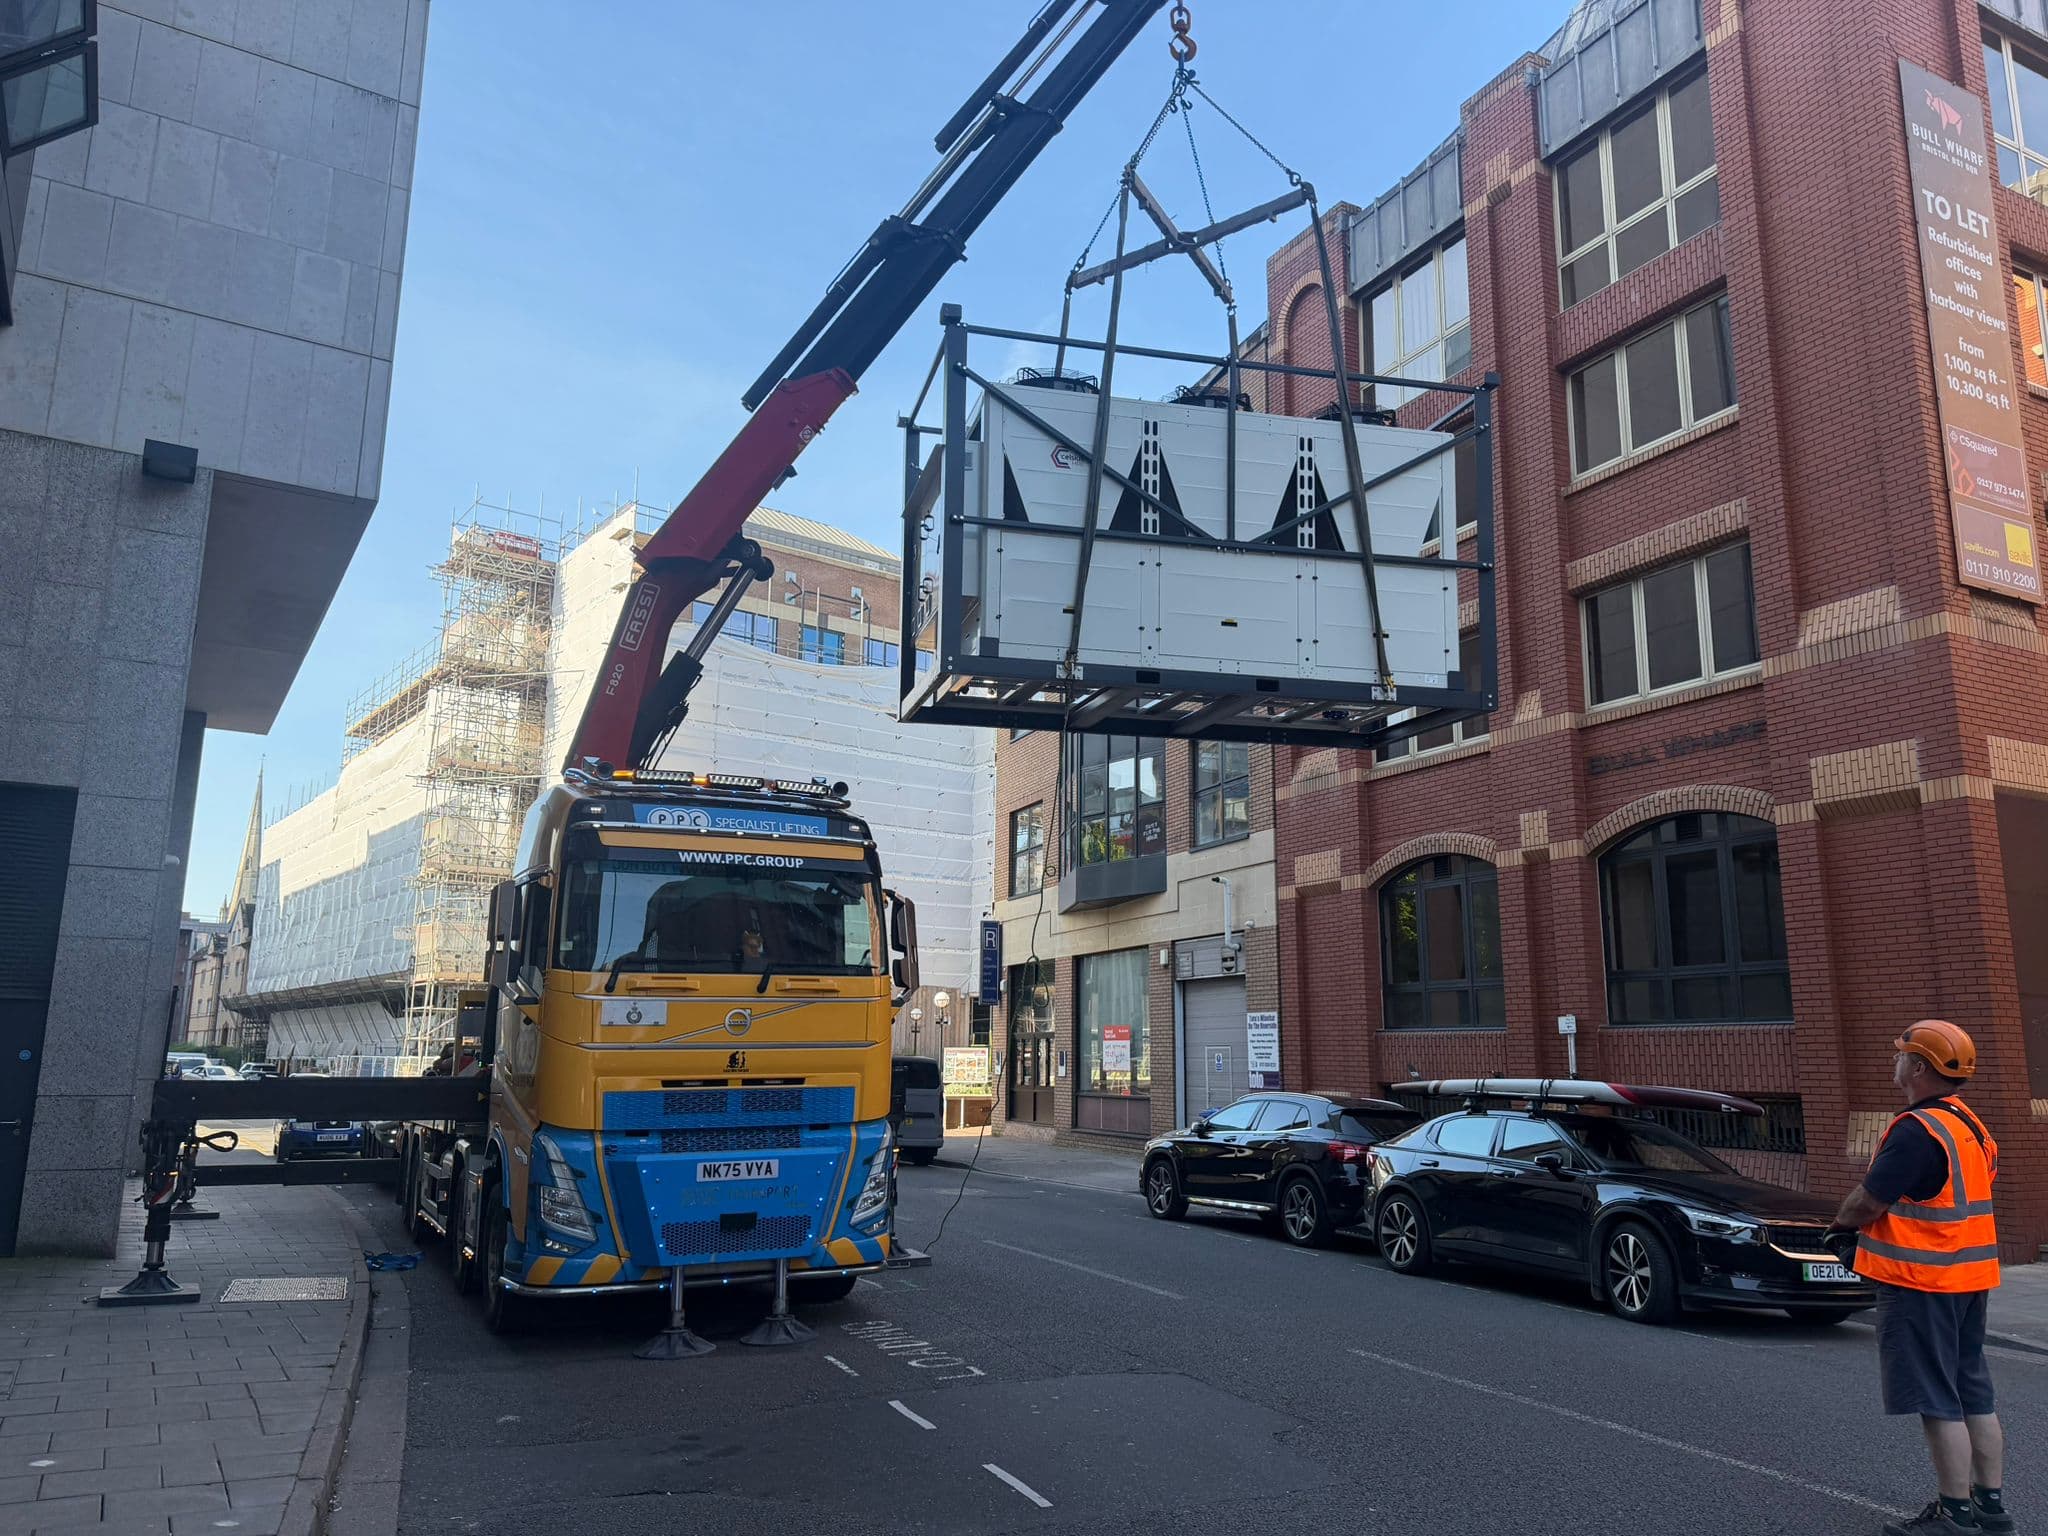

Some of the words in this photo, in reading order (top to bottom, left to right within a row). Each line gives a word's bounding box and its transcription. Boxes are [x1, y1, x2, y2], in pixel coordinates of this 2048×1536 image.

[1911, 122, 1941, 147] BULL
[1945, 137, 1984, 166] WHARF
[1921, 142, 1950, 162] BRISTOL
[1921, 188, 1952, 221] TO
[1955, 203, 1990, 239] LET
[1928, 226, 1993, 267] Refurbished
[1945, 256, 1982, 281] offices
[1954, 280, 1979, 300] with
[1929, 288, 1975, 318] harbour
[1976, 309, 2007, 332] views
[1958, 336, 1985, 360] from
[1943, 352, 1972, 376] 1,100
[1973, 365, 1987, 385] sq
[1987, 367, 1999, 387] ft
[1946, 374, 1984, 401] 10,300
[1984, 390, 1999, 410] sq
[2000, 393, 2011, 411] ft
[1959, 434, 1998, 458] CSquared
[1966, 558, 1990, 577] 0117
[1992, 566, 2011, 583] 910
[2012, 571, 2037, 590] 2200
[625, 588, 656, 645] FASSI
[605, 663, 625, 696] F820
[715, 816, 776, 832] SPECIALIST
[778, 820, 820, 836] LIFTING
[678, 851, 804, 869] WWW.PPC.GROUP
[985, 930, 996, 948] R
[702, 1162, 741, 1179] NK75
[745, 1161, 774, 1177] VYA
